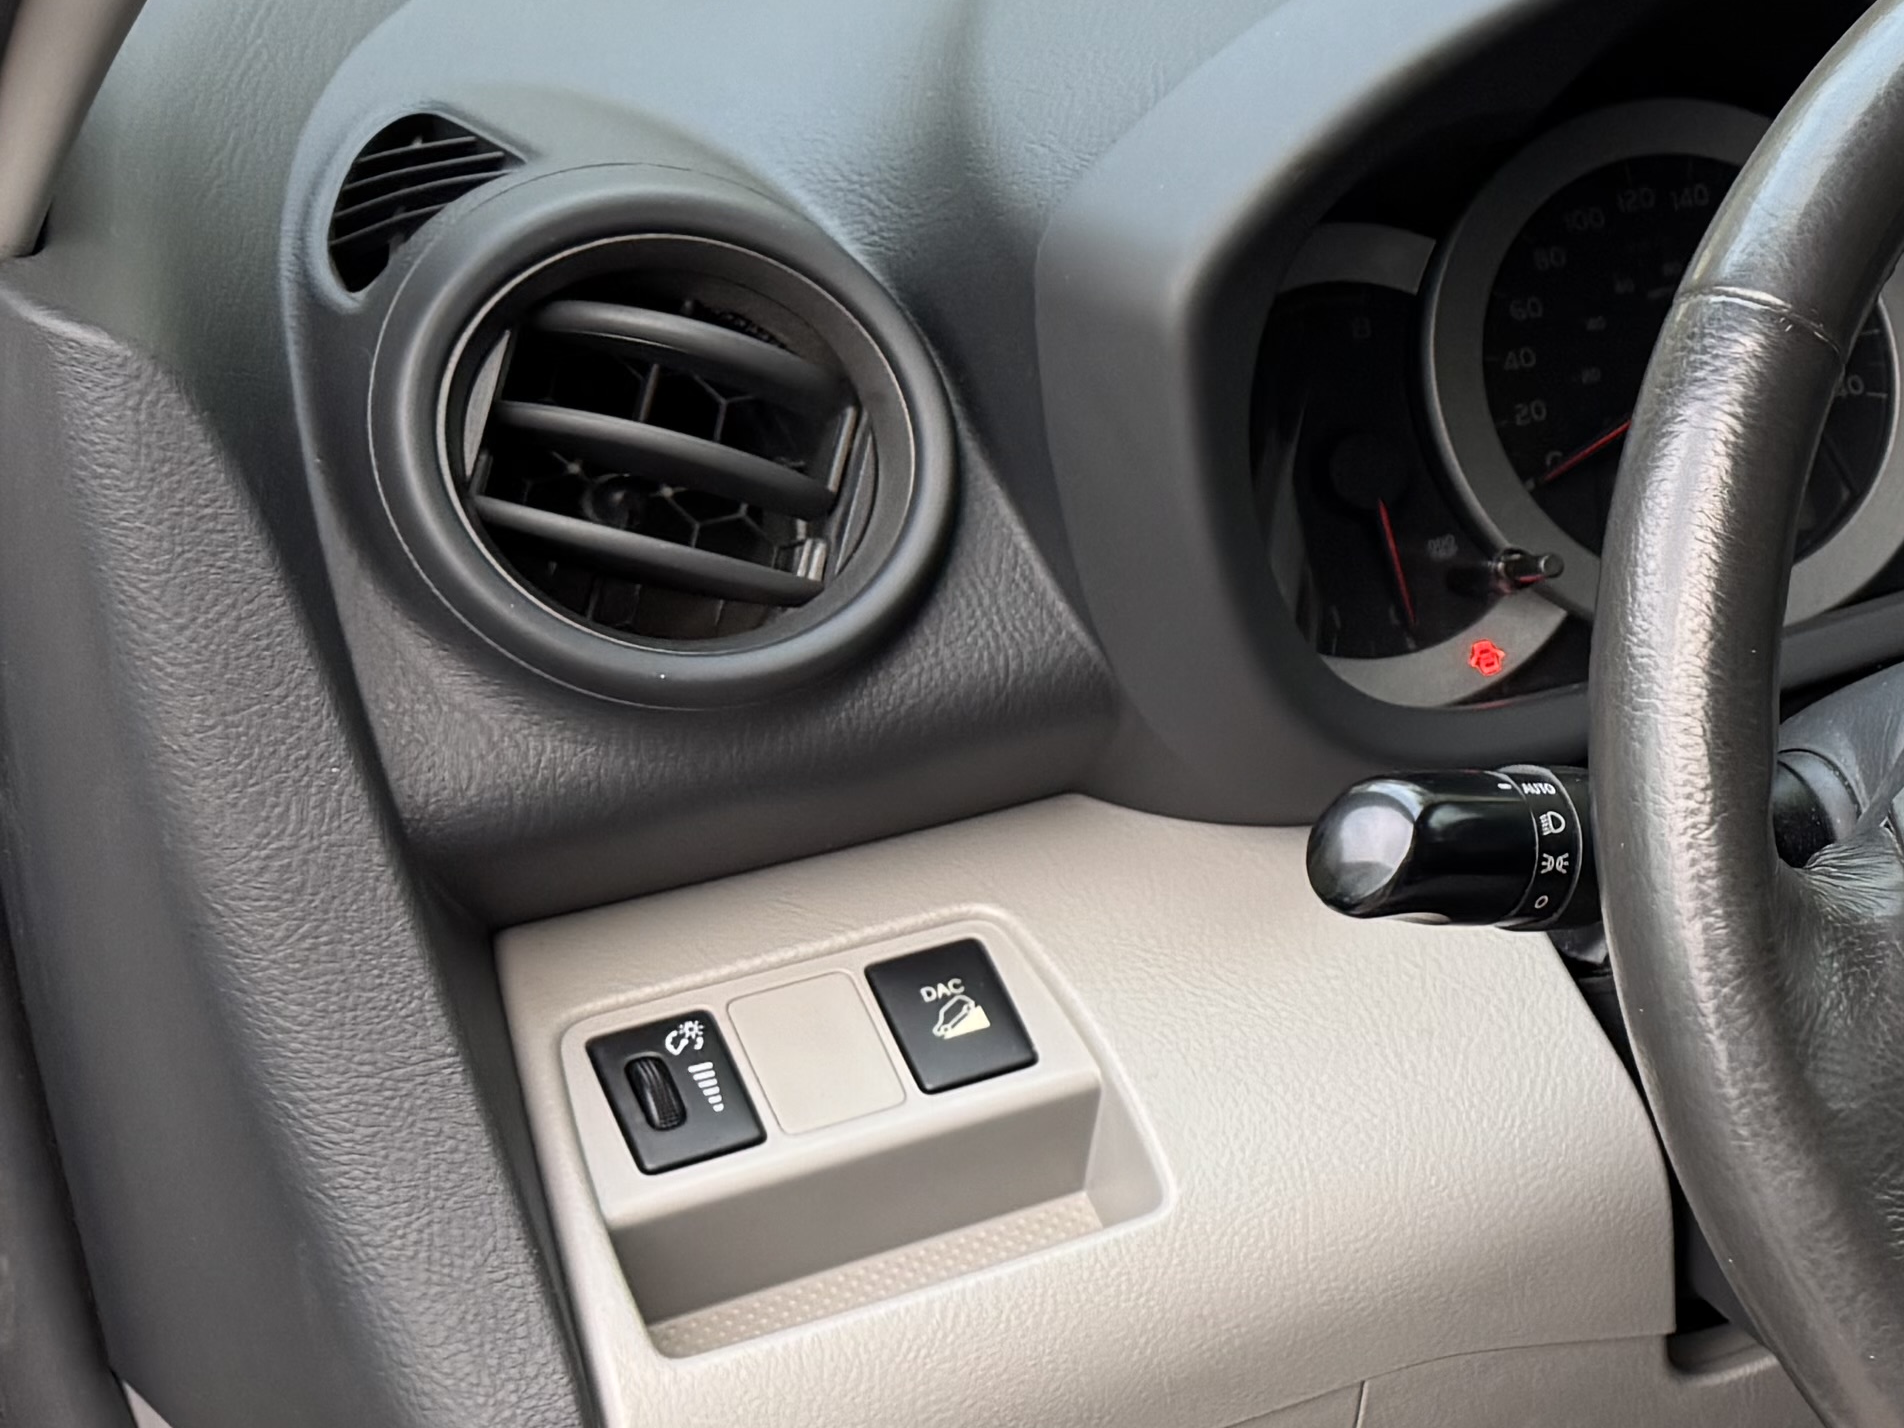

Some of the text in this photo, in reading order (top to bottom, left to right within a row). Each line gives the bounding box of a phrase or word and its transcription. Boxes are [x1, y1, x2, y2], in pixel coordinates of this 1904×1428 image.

[1509, 297, 1543, 321] 60
[1504, 347, 1536, 372] 40
[1514, 400, 1547, 426] 20
[1521, 782, 1556, 794] AUTO
[920, 978, 965, 1003] DAC
